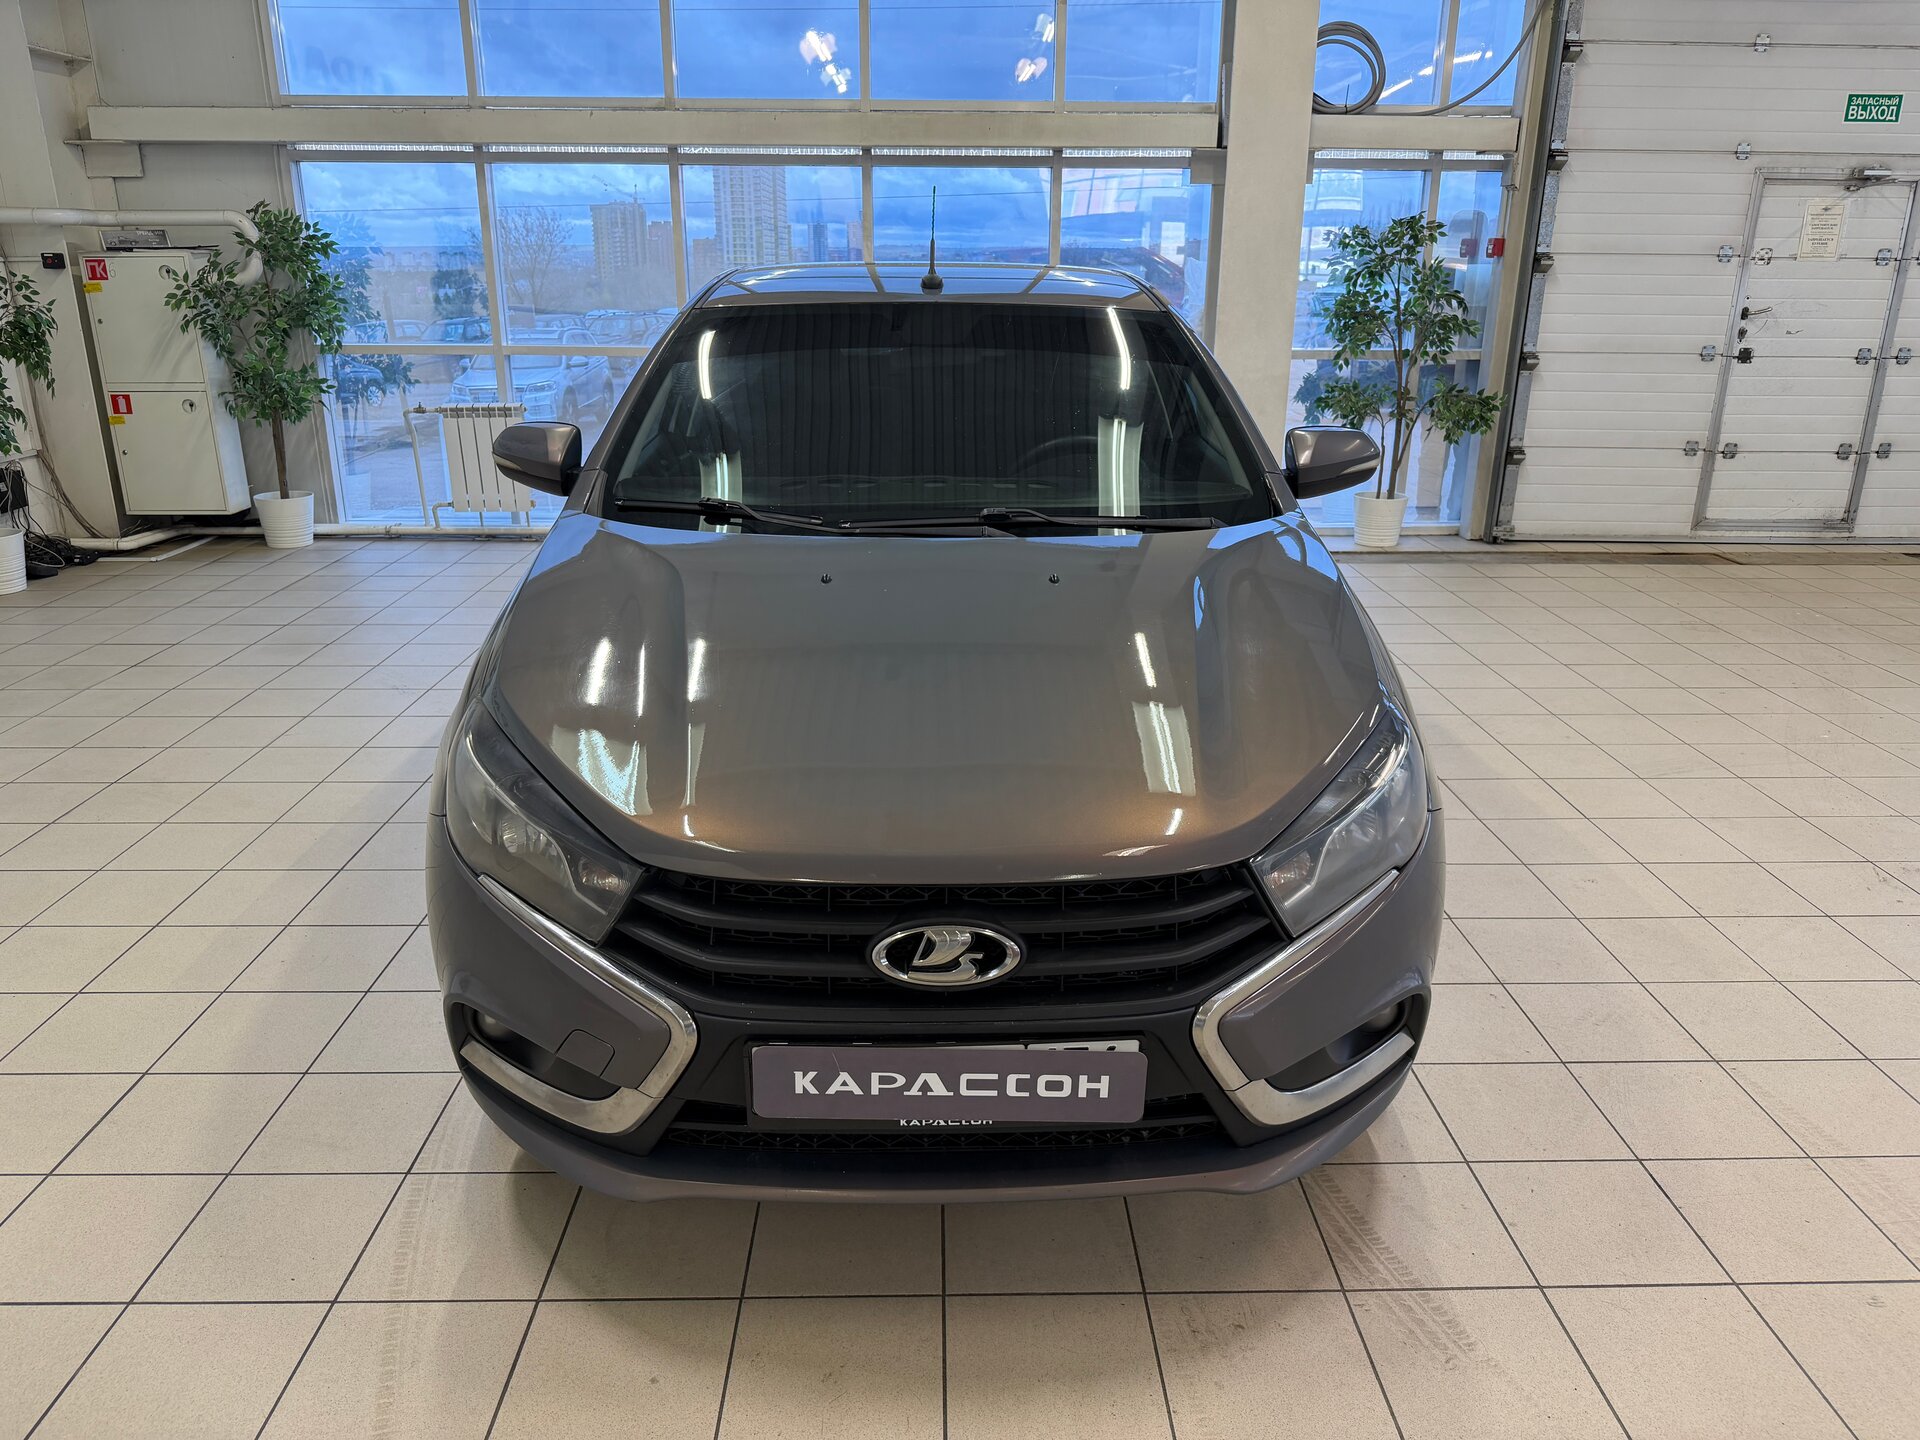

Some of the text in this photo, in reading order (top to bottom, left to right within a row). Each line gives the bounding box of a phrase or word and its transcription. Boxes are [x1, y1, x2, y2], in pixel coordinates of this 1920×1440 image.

[1851, 96, 1899, 105] ЗАПАСНЫЙ
[1848, 106, 1897, 121] ВЫХОД
[86, 261, 108, 278] ПК
